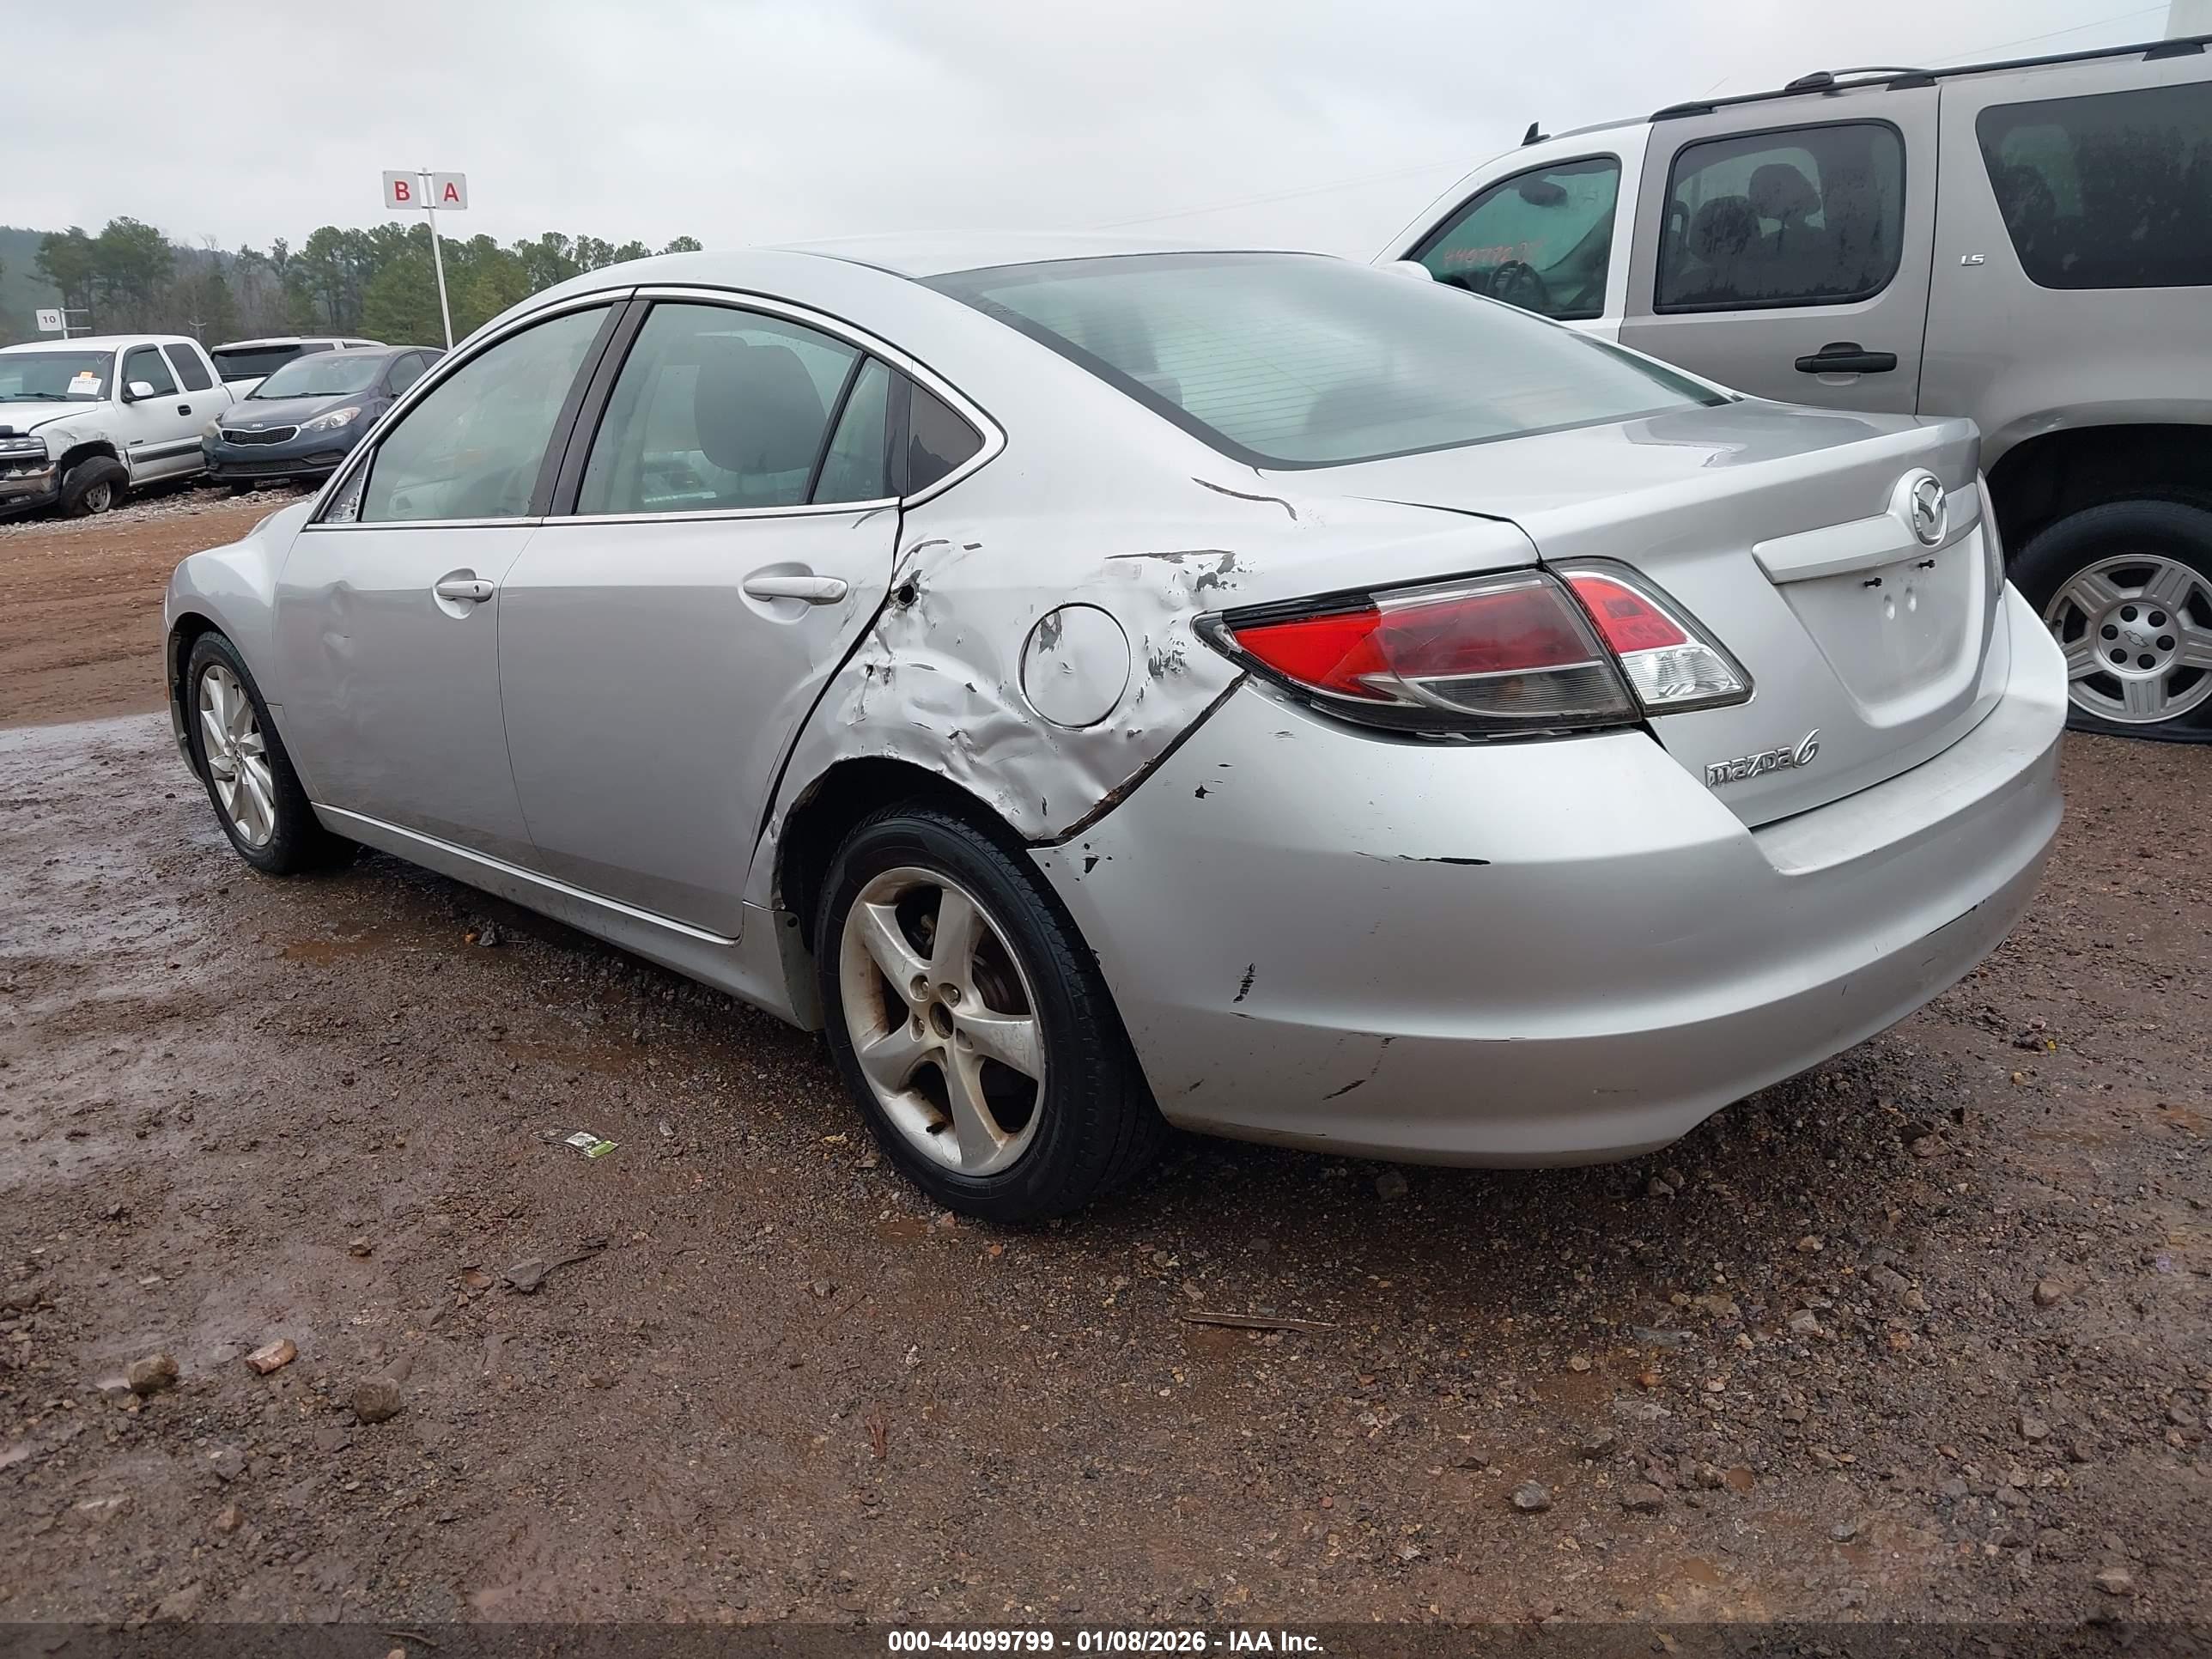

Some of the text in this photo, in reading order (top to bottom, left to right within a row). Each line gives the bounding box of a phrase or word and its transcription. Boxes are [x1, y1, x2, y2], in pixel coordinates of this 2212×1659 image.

[394, 180, 410, 201] B
[443, 182, 459, 202] A
[42, 315, 57, 324] 10
